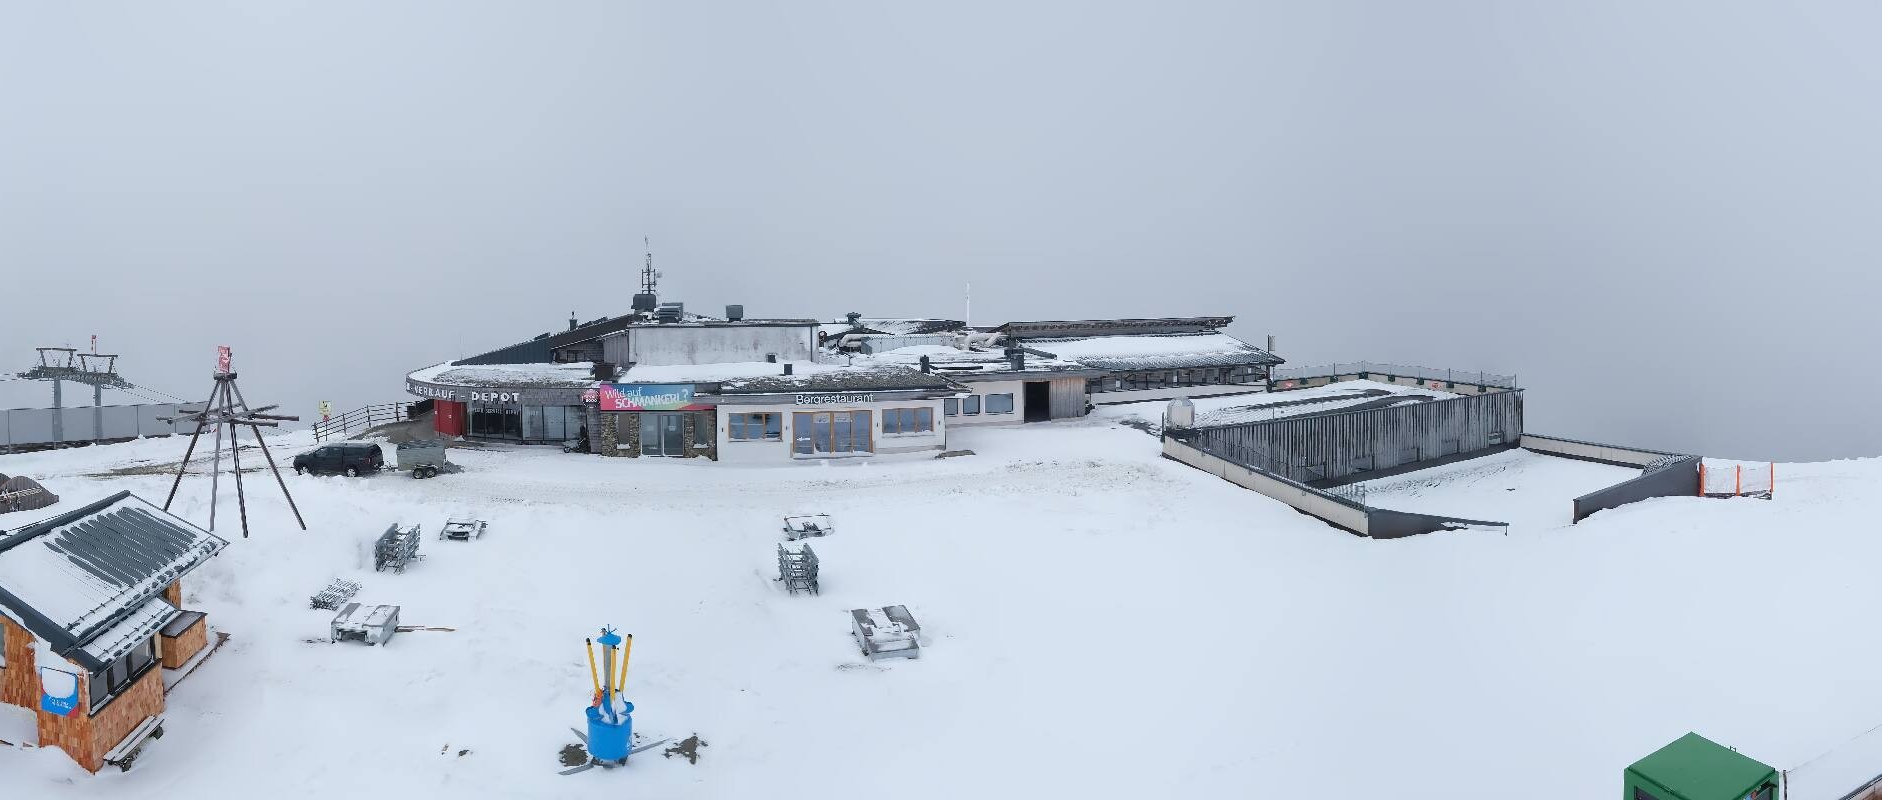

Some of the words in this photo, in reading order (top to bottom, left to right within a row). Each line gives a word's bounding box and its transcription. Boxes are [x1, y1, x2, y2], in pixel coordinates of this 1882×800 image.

[414, 385, 455, 399] VERKAUF
[471, 391, 520, 402] DEPOT
[605, 389, 625, 400] Wild
[626, 386, 642, 397] auf
[795, 393, 875, 405] Bergrestaurant
